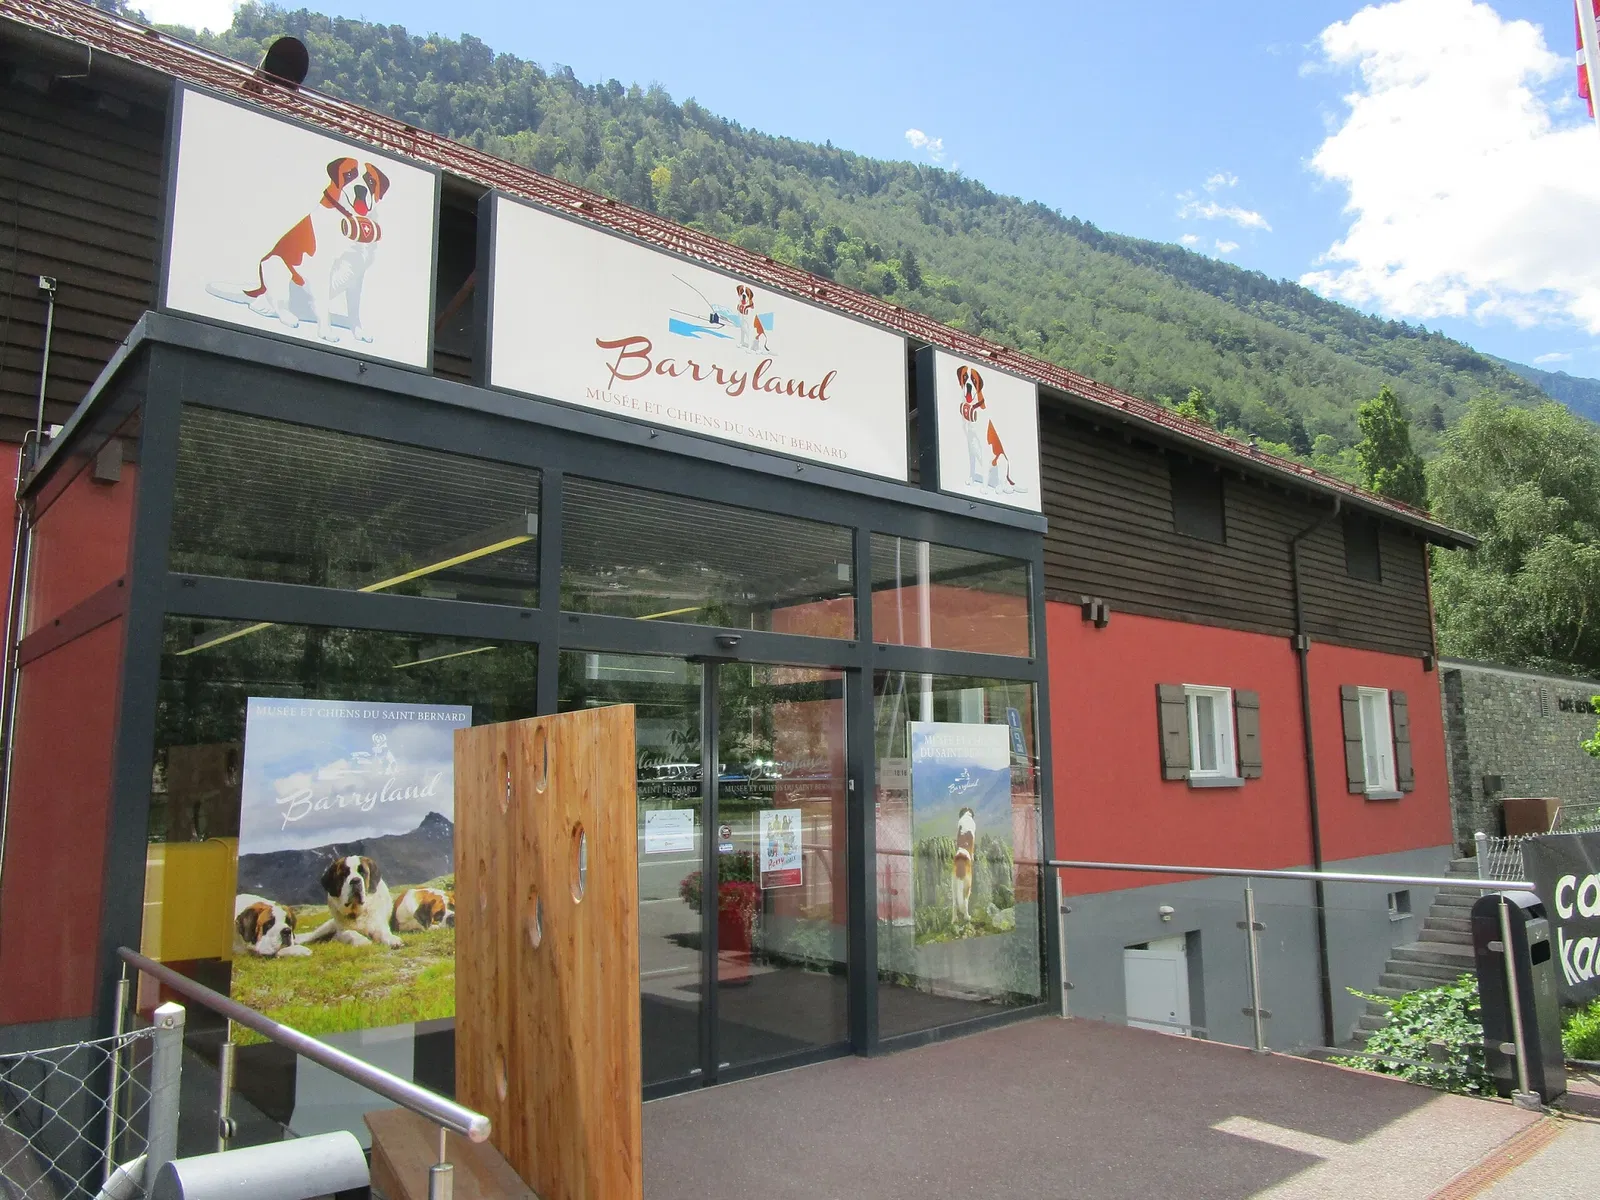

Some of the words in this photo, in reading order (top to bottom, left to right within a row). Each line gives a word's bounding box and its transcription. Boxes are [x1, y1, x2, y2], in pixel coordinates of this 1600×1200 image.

[595, 336, 838, 401] Barryland
[586, 387, 640, 410] MUSÉE
[645, 401, 662, 415] ET
[666, 407, 721, 430] CHIENS
[724, 421, 744, 435] DU
[748, 427, 787, 445] SAINT
[791, 437, 847, 460] BERNARD
[256, 705, 297, 717] MUSÉE
[300, 707, 315, 717] ET
[317, 708, 360, 719] CHIENS
[363, 710, 380, 719] DU
[382, 711, 415, 720] SAINT
[418, 712, 466, 722] BERNARD
[920, 747, 935, 758] DU
[275, 772, 443, 831] Barryland
[1557, 927, 1600, 986] ka
